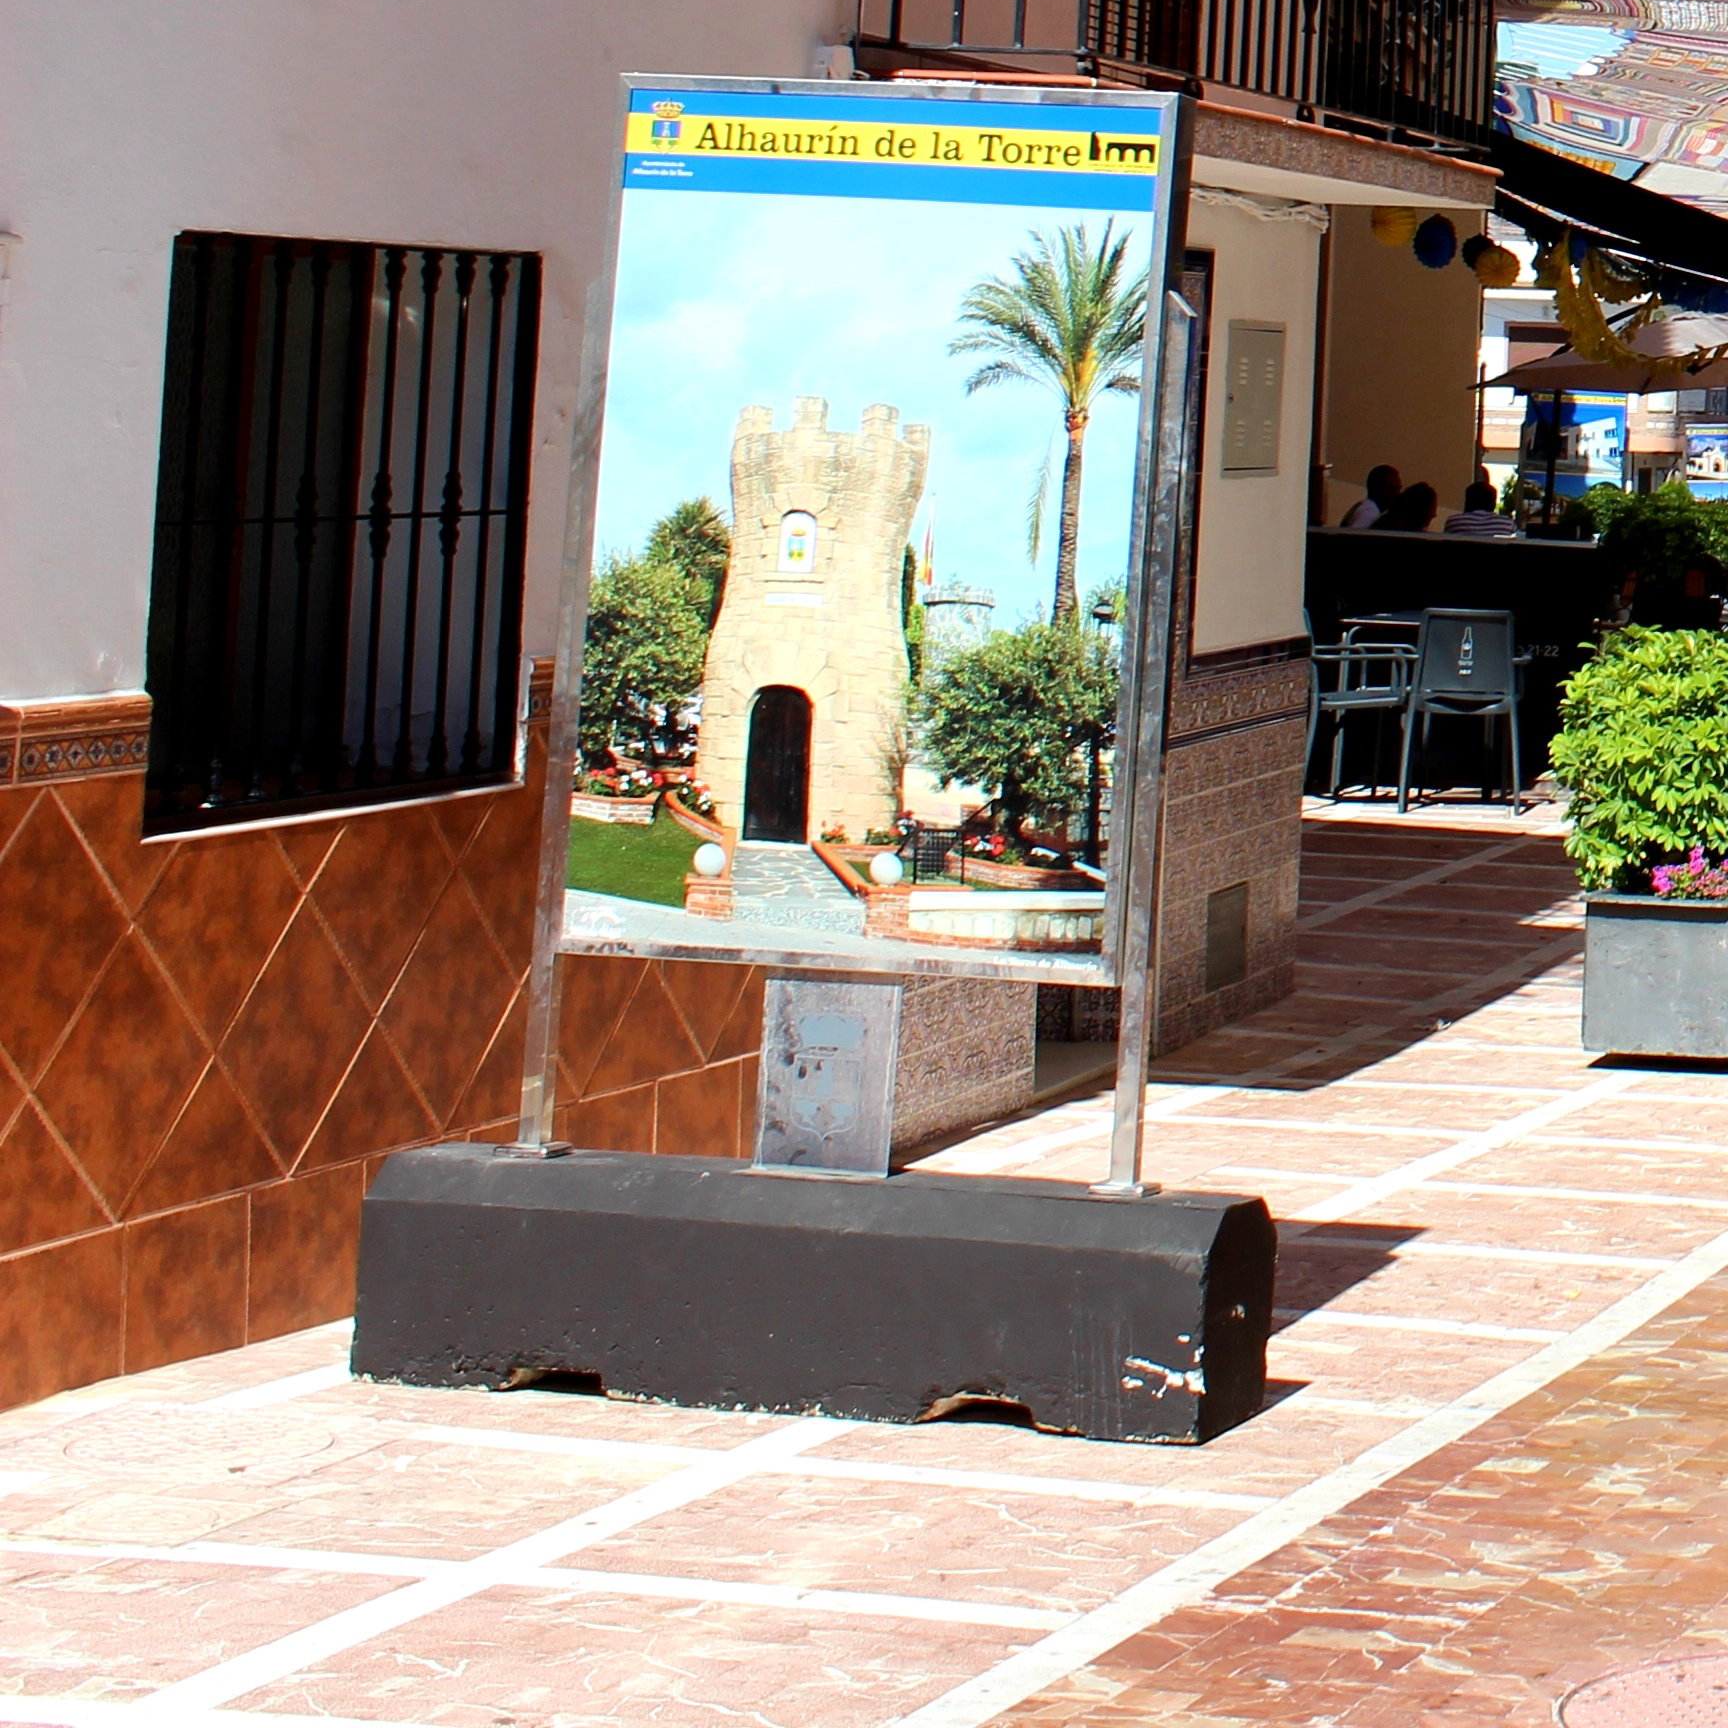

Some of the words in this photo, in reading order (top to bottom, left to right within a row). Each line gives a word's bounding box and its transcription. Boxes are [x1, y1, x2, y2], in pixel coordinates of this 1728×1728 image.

[695, 121, 860, 156] Alhaurín
[874, 129, 916, 159] de
[930, 131, 964, 161] la
[978, 133, 1082, 167] Torre
